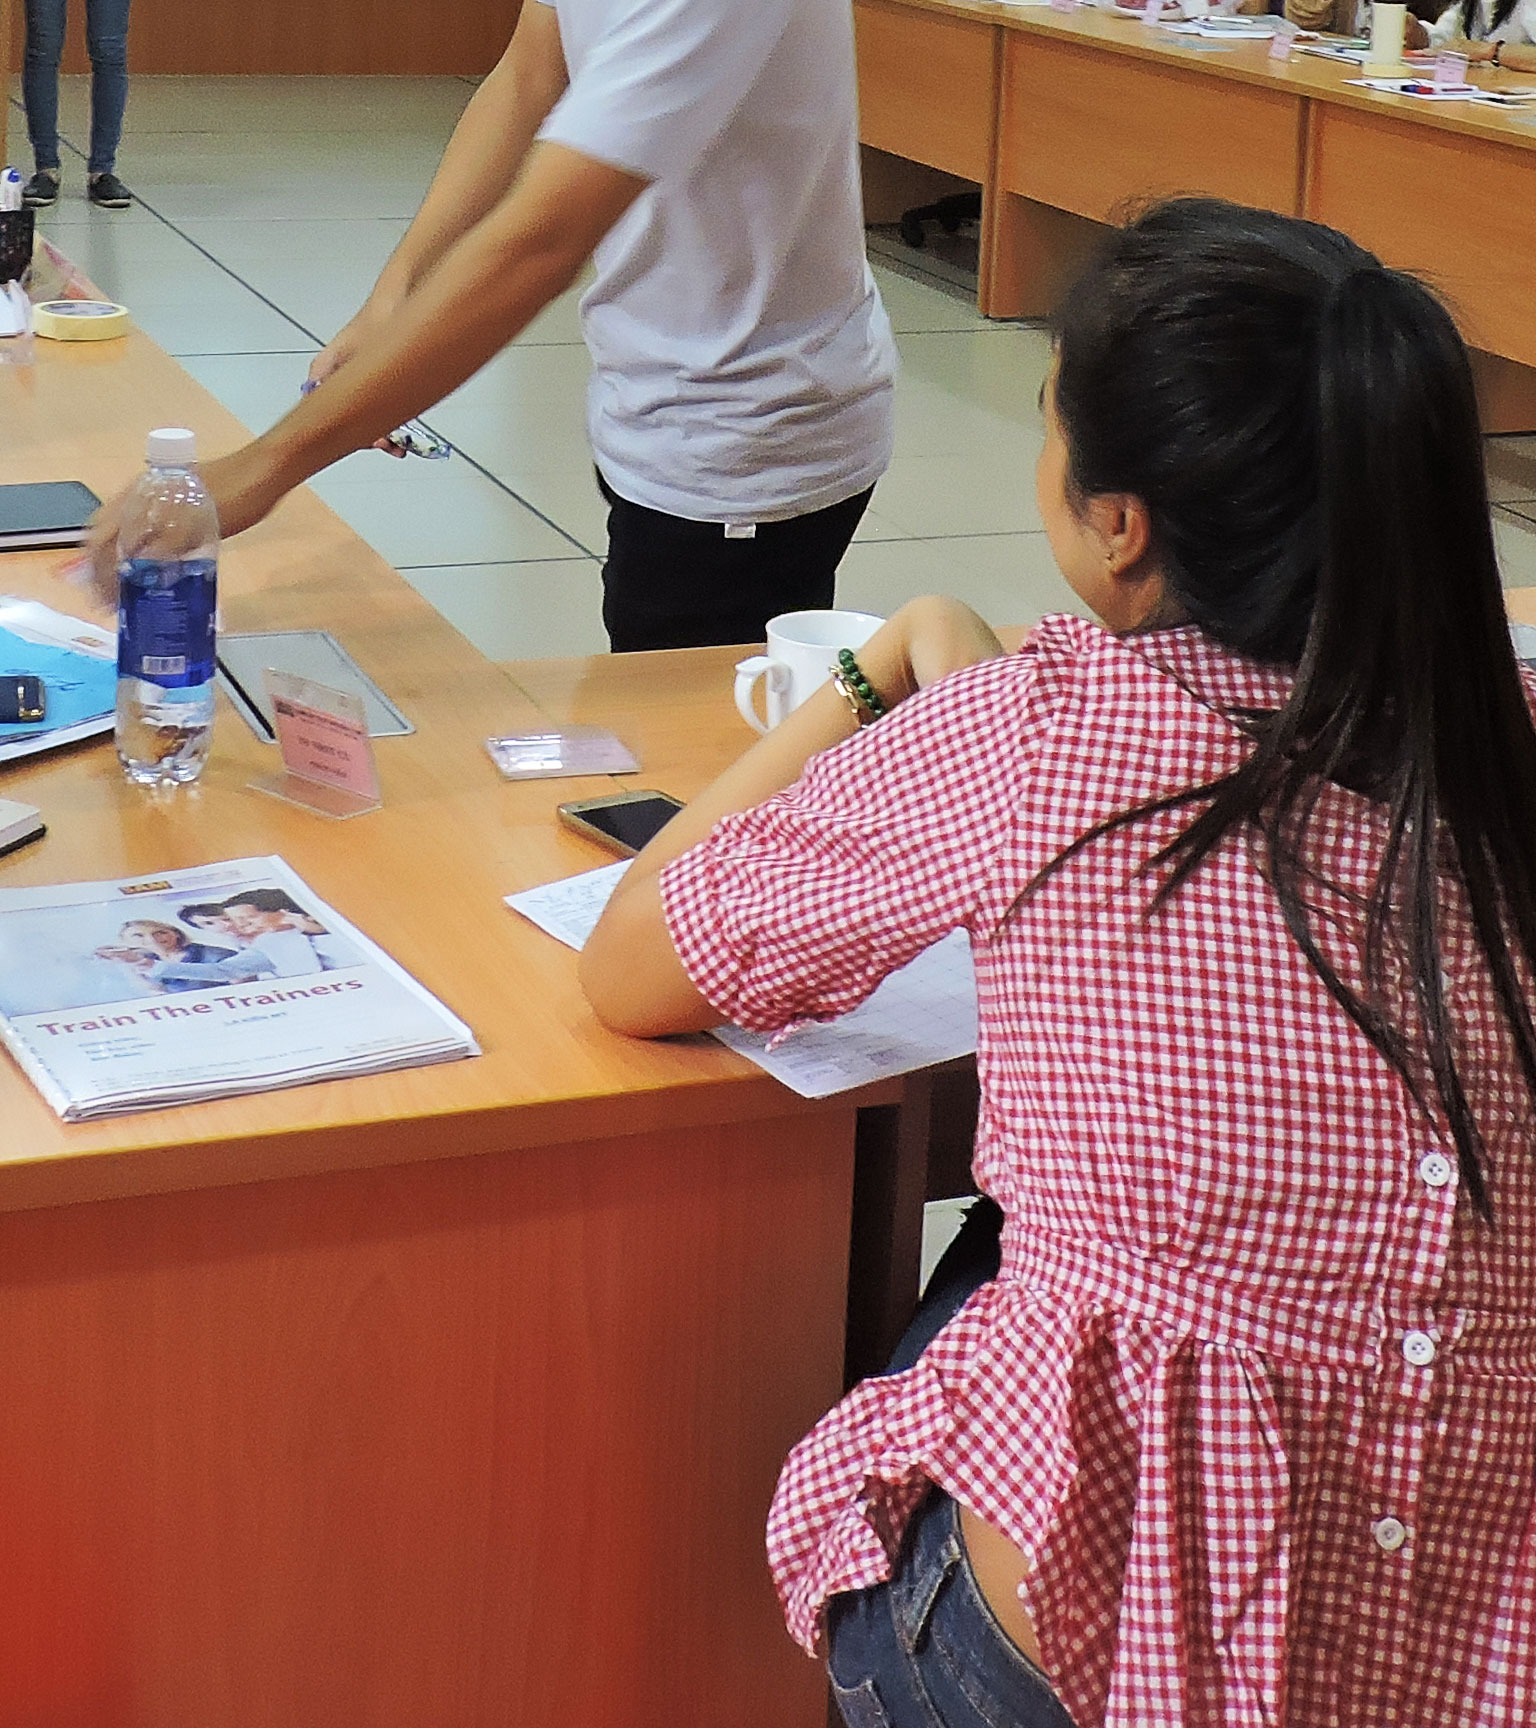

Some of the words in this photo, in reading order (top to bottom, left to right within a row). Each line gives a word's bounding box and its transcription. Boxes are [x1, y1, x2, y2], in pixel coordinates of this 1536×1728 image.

[37, 1011, 139, 1040] Train
[140, 999, 213, 1025] The
[213, 975, 364, 1013] Trainers
